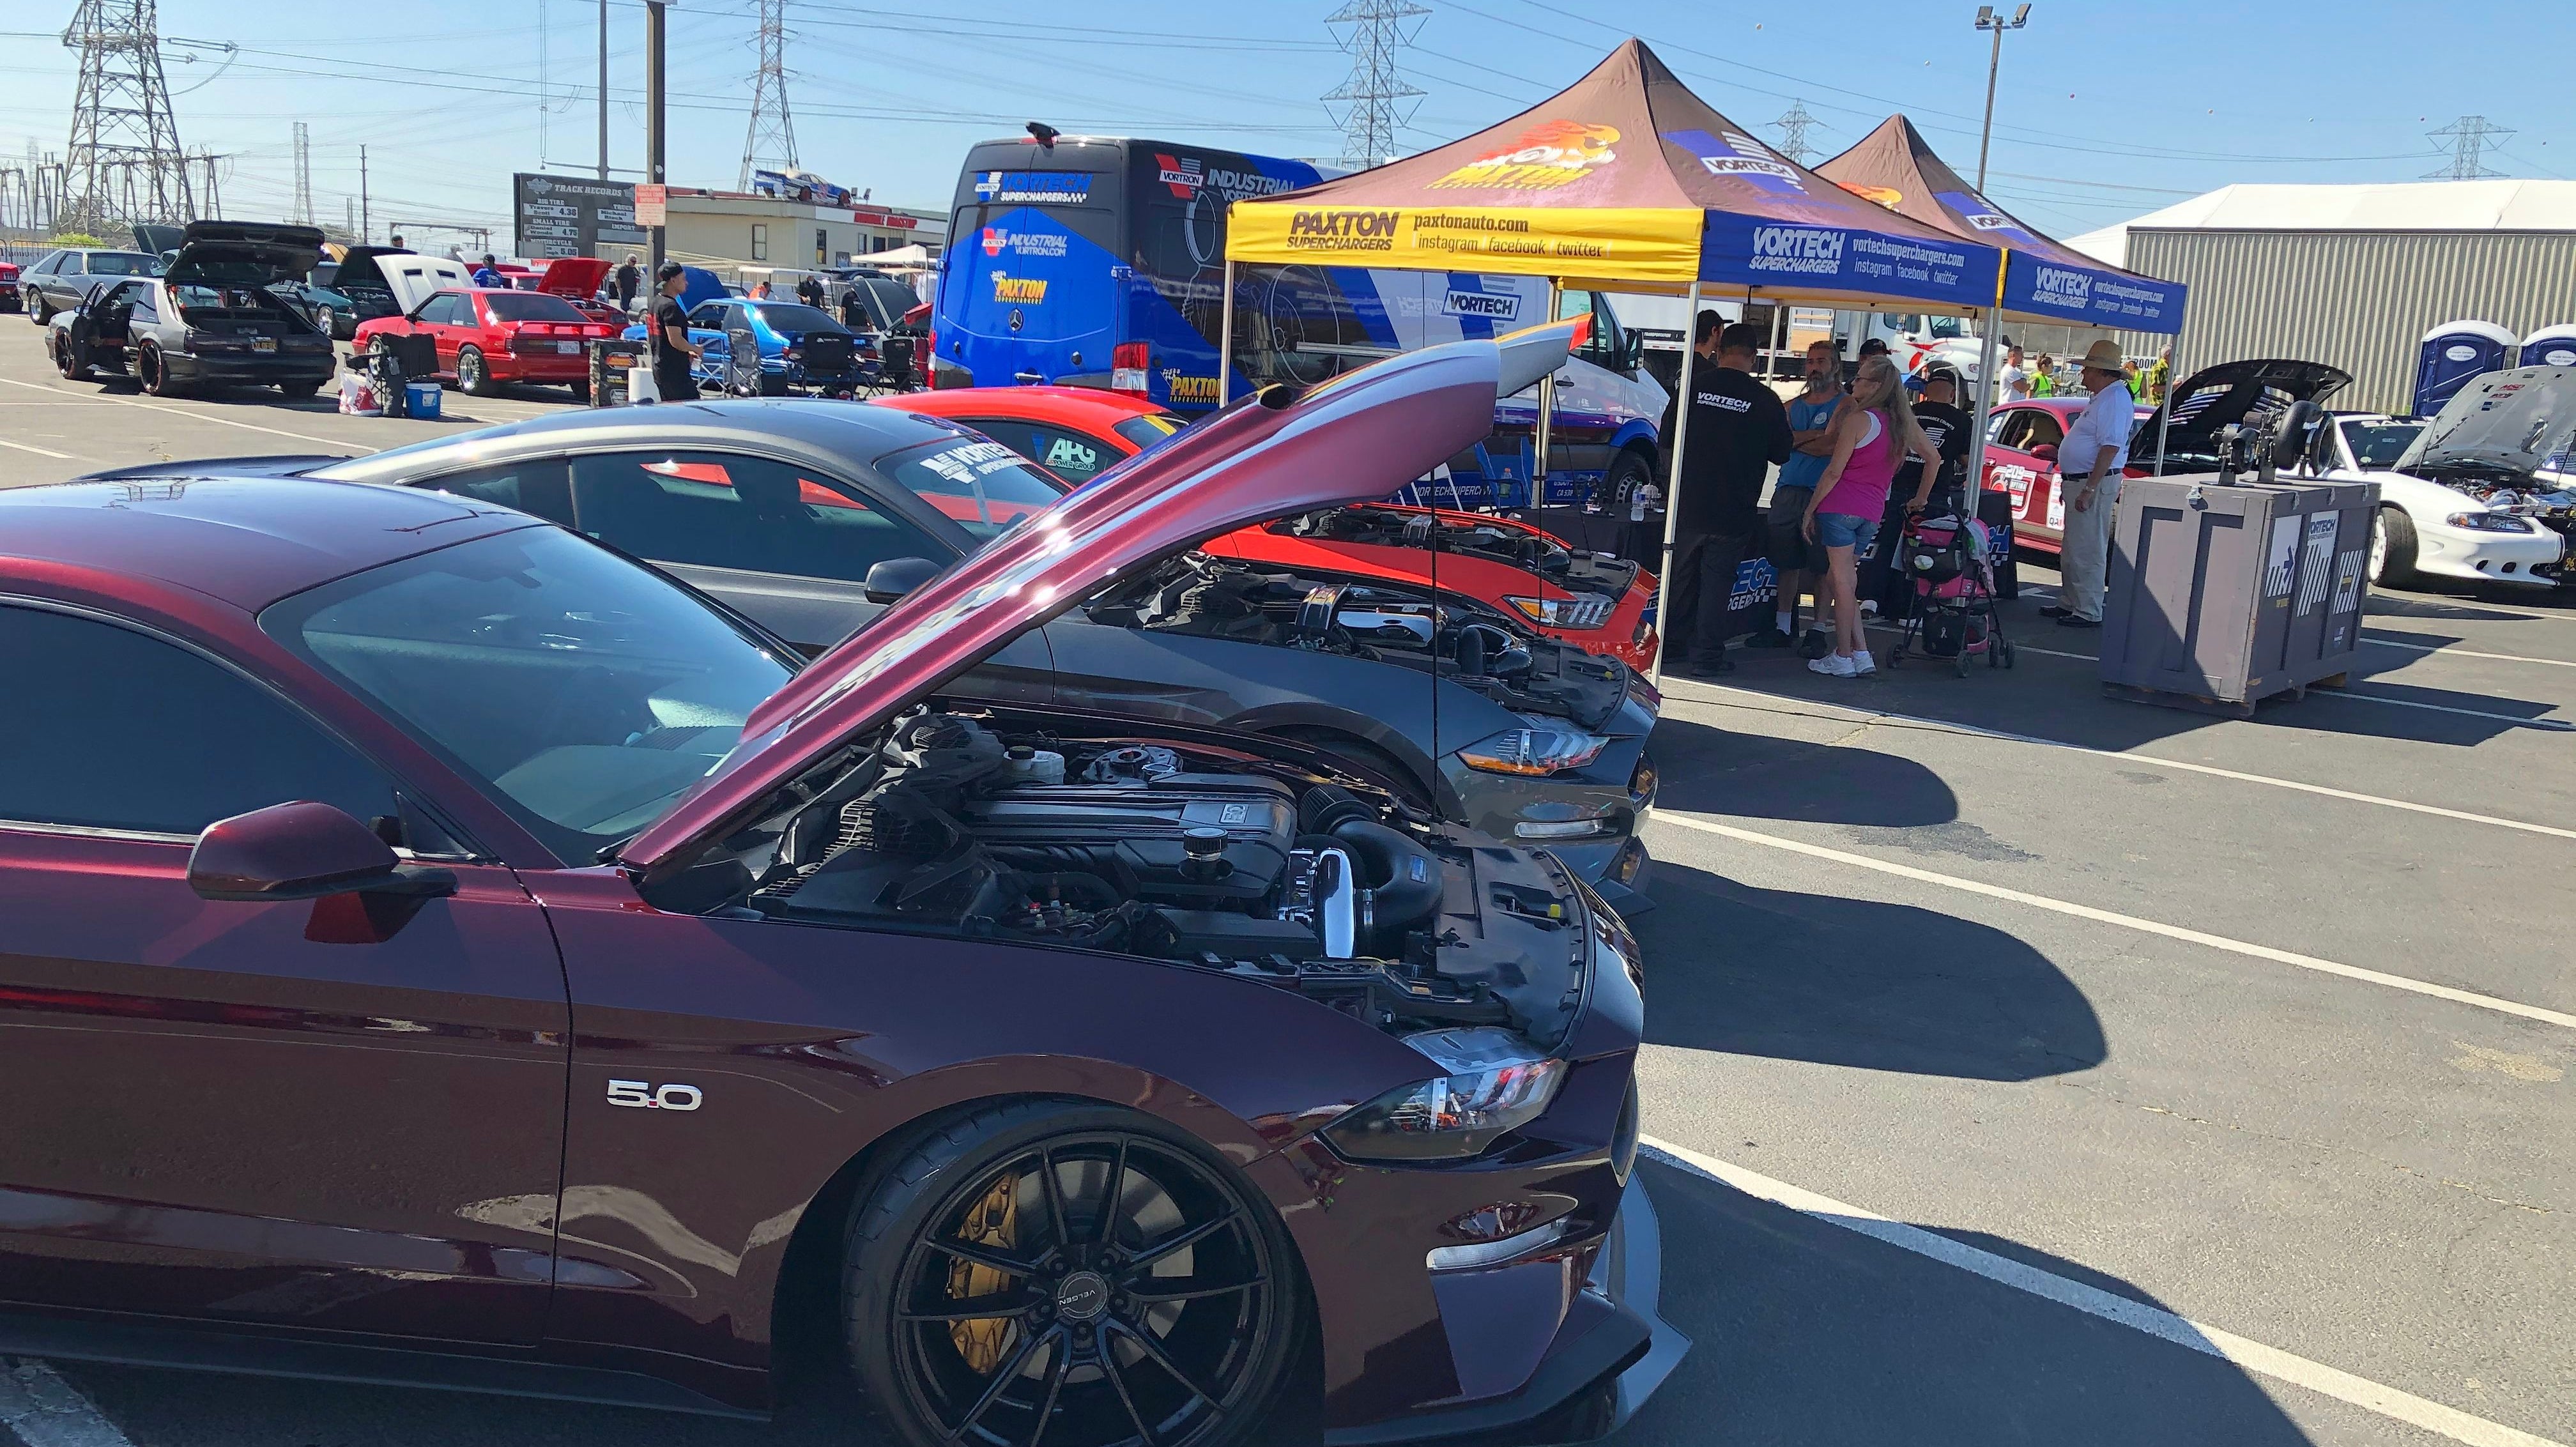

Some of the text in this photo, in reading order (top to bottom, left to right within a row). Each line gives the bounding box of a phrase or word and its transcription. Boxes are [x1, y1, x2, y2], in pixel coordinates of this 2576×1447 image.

[1163, 172, 1200, 185] VORTRON
[1706, 160, 1795, 178] VORTECH
[555, 184, 622, 196] TRACK RECORDS
[1002, 172, 1094, 192] VORTECH
[1000, 192, 1068, 203] SUPERCHARGERS
[1291, 211, 1400, 237] PAXTON
[1413, 213, 1529, 233] paxtonauto.com
[1008, 233, 1068, 248] INDUSTRIAL
[1287, 236, 1393, 250] SUPERCHARGERS
[1418, 234, 1603, 257] instagram facebook twitter
[1753, 227, 1846, 259] VORTECH
[1015, 246, 1066, 257] VORTRON.COM
[1853, 237, 1965, 268] vortechsuperchargers.com
[1749, 256, 1841, 275] SUPERCHARGERS
[1854, 257, 1959, 286] instagram facebook twitter
[996, 278, 1048, 298] PAXTON
[2036, 266, 2093, 297] VORTECH
[1450, 293, 1514, 315] VORTECH
[2032, 289, 2089, 309] SUPERCHARGERS
[1696, 399, 1737, 411] SUPERCHARGERS
[1697, 392, 1752, 410] VORTECH
[2310, 518, 2336, 535] ORTECH
[606, 1079, 703, 1111] 5.0
[1059, 1289, 1096, 1306] VELGEN
